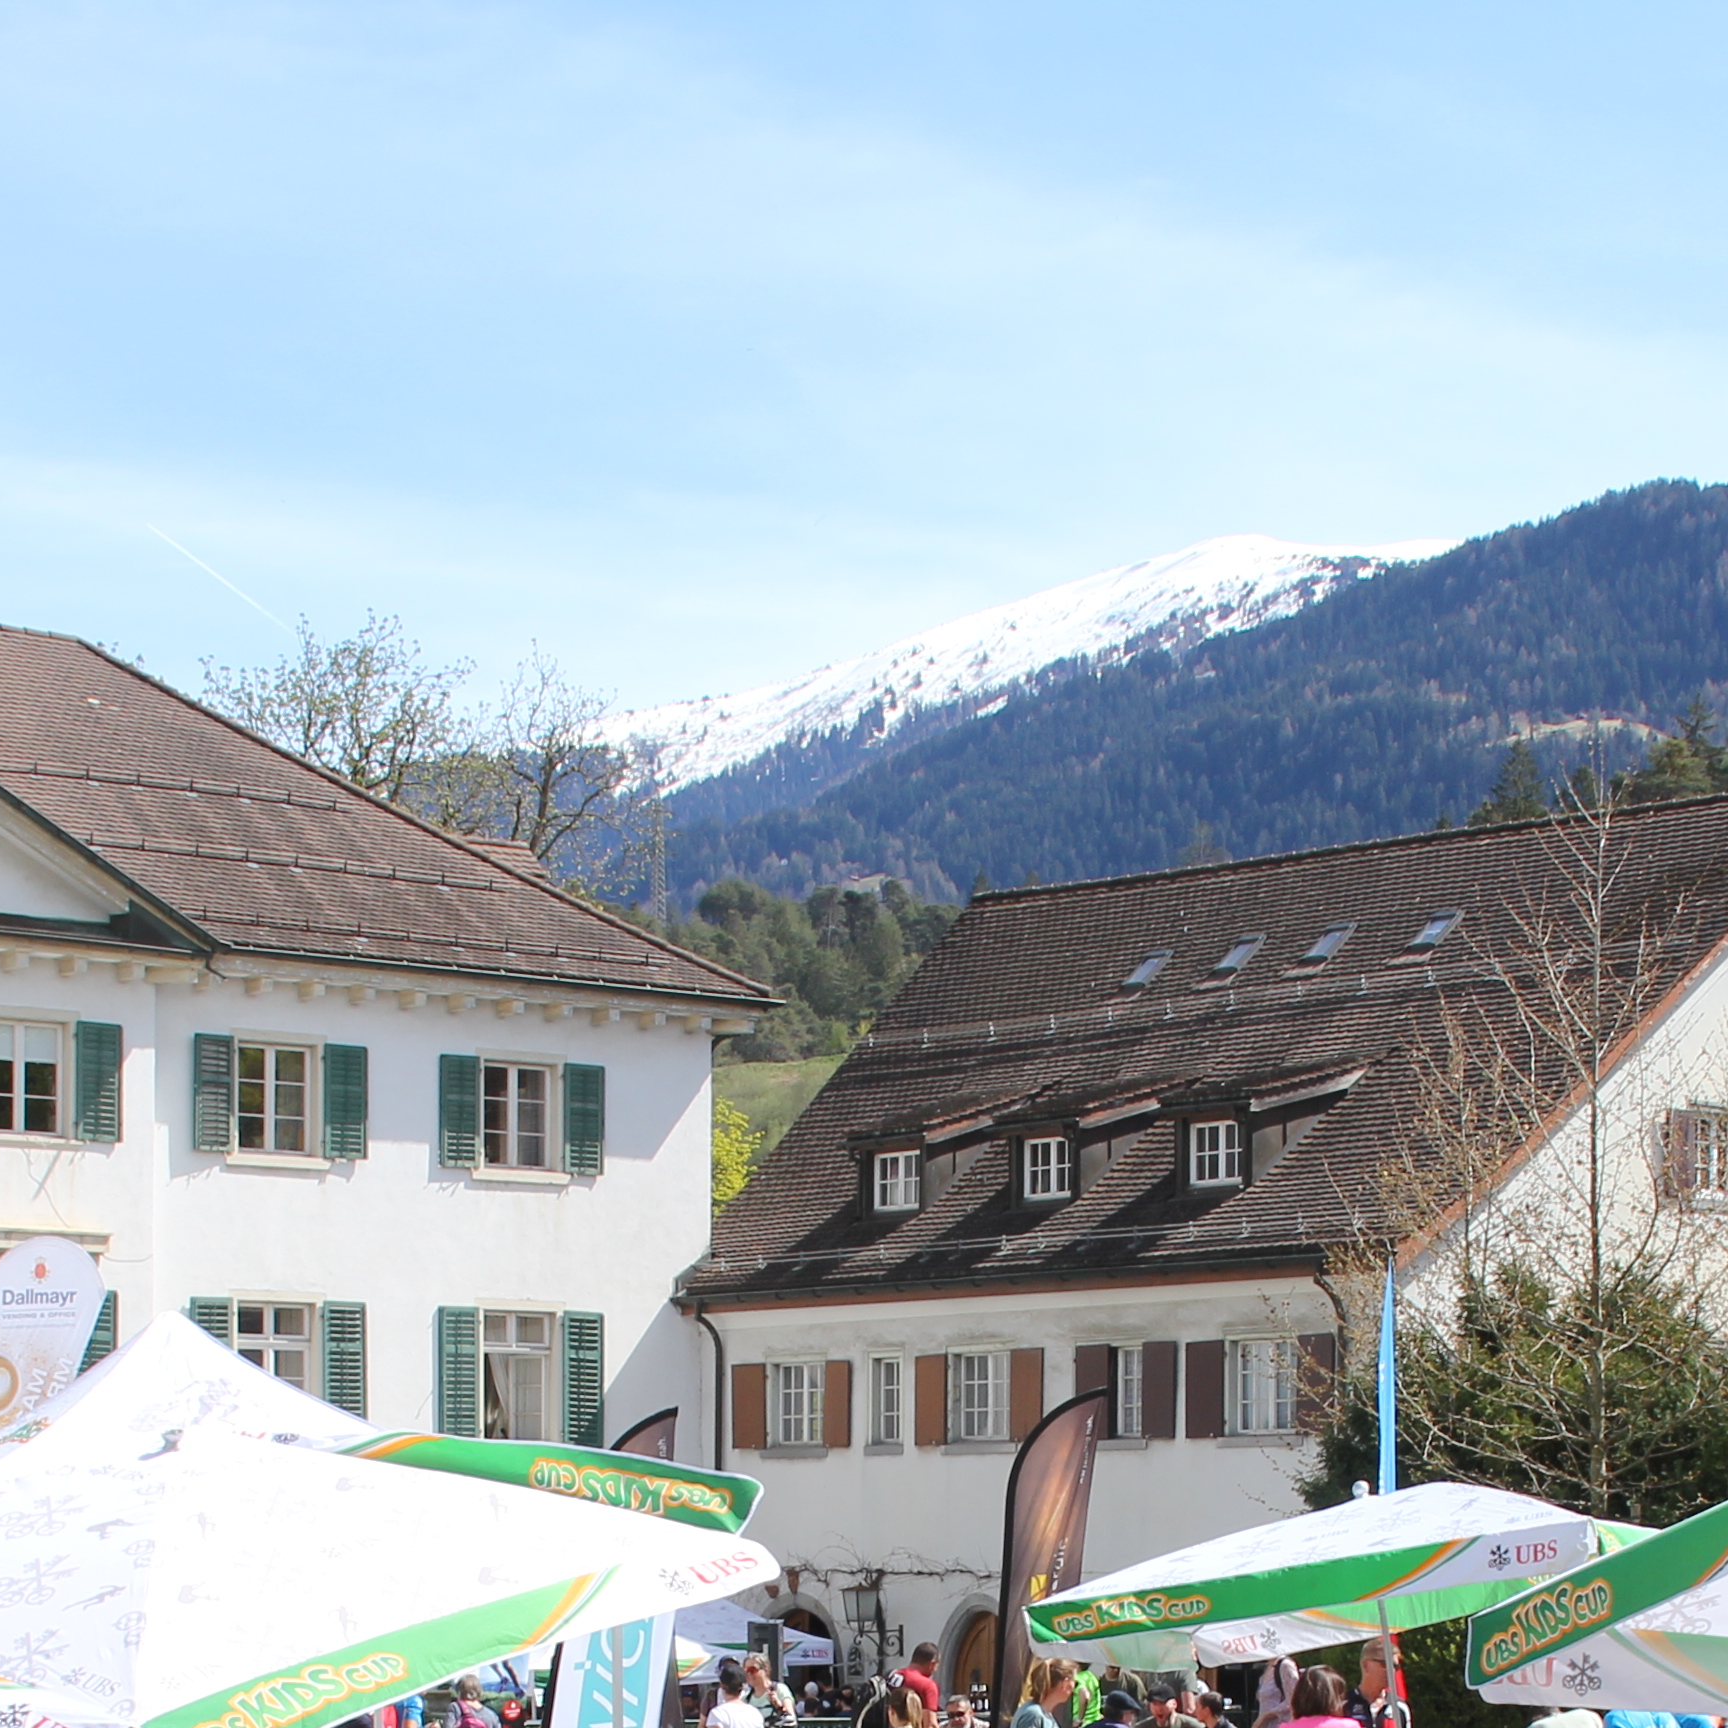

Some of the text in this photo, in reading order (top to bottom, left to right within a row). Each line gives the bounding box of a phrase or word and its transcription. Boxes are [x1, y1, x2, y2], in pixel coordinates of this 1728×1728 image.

[2, 1289, 77, 1307] Dallmayr
[580, 1469, 670, 1514] KIDS
[687, 1551, 759, 1585] UBS
[1514, 1539, 1559, 1565] UBS
[1056, 1597, 1209, 1635] UBS KIDS CUP
[1483, 1630, 1522, 1672] UBS
[1512, 1584, 1573, 1652] KIDS
[1573, 1582, 1610, 1624] CUP
[82, 1672, 122, 1698] UBS
[342, 1654, 405, 1690] CUP
